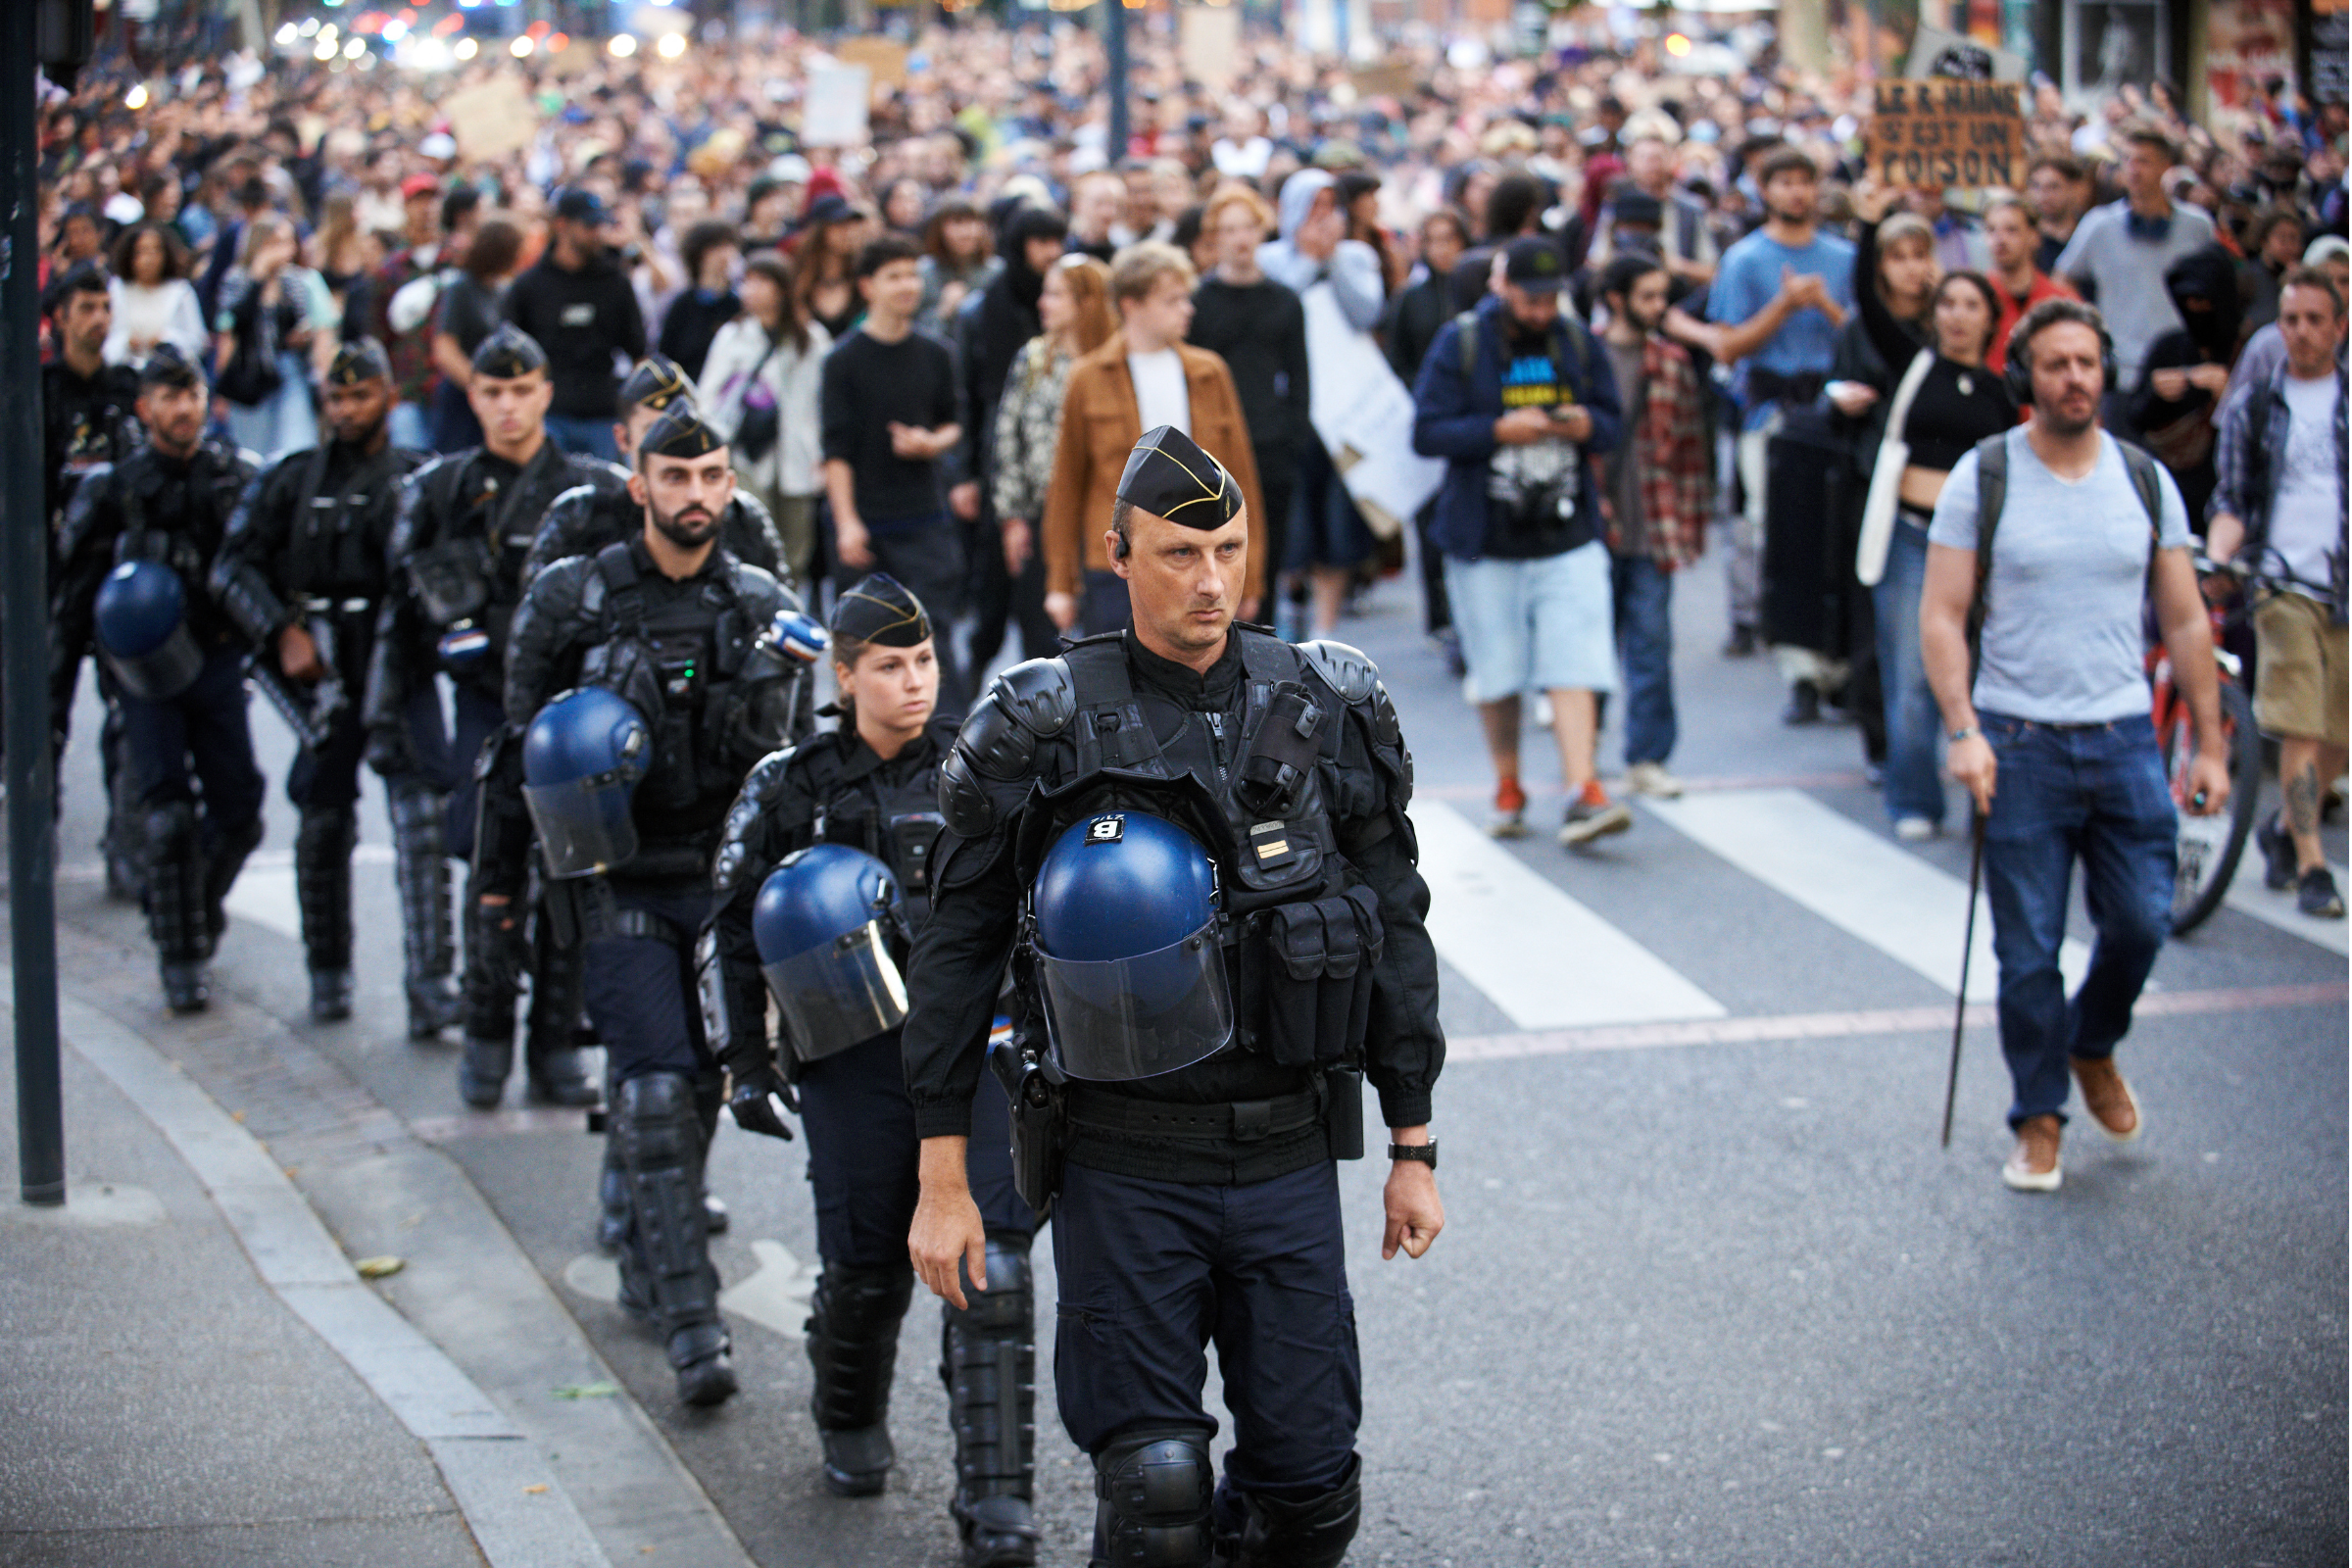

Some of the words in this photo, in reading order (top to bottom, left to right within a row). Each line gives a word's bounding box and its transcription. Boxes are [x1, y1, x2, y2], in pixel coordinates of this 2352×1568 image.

[1970, 120, 2009, 145] UN
[1883, 150, 2011, 185] POISON
[1093, 820, 1119, 838] B
